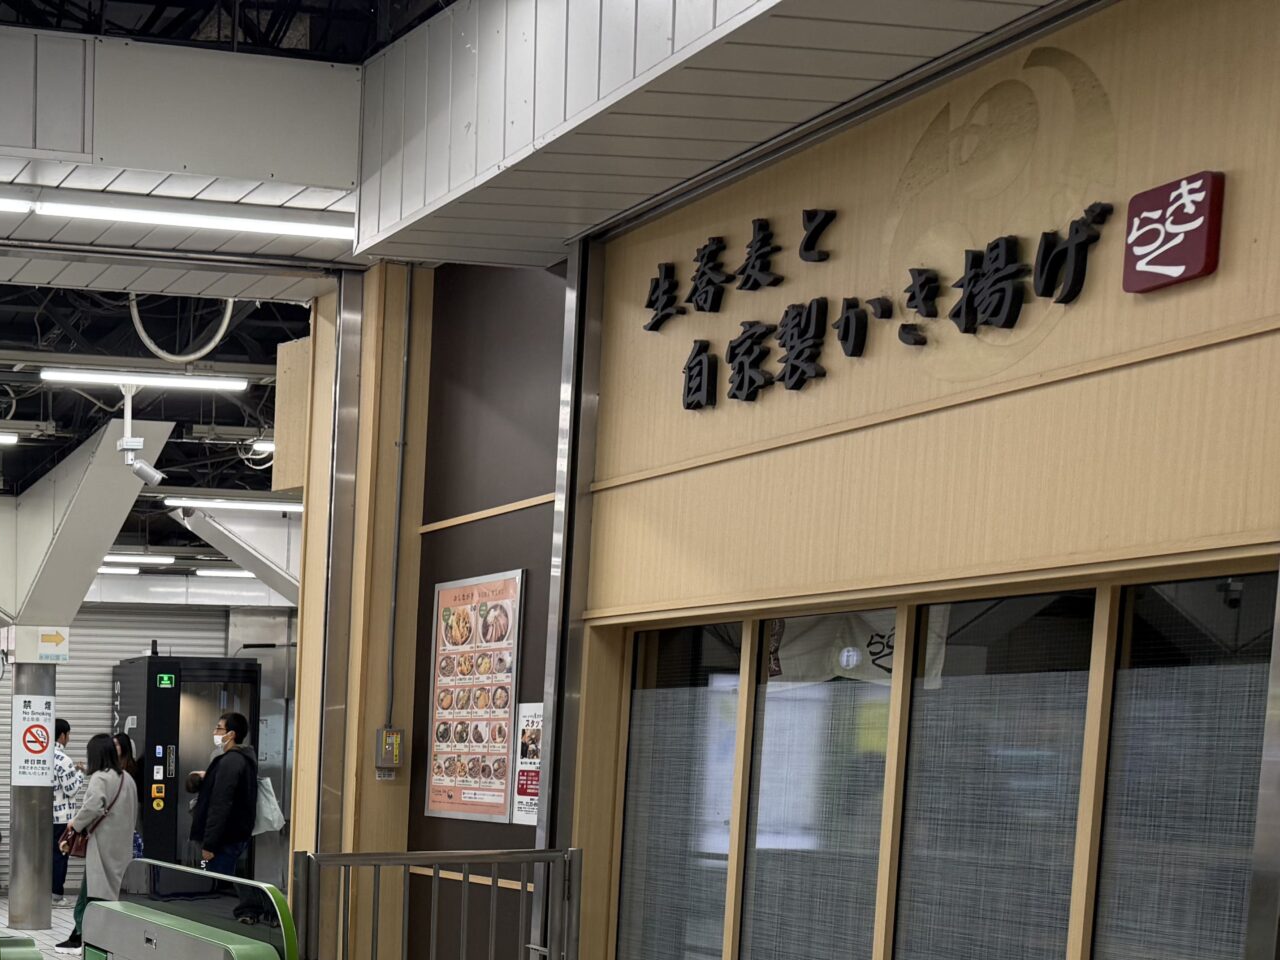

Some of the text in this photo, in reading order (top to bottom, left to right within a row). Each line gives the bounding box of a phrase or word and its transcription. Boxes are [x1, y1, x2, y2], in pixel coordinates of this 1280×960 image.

[643, 210, 837, 331] 生蕎麦と
[1126, 179, 1206, 277] きらく
[682, 202, 1114, 410] 自家製かき揚げ
[23, 700, 52, 711] 禁煙
